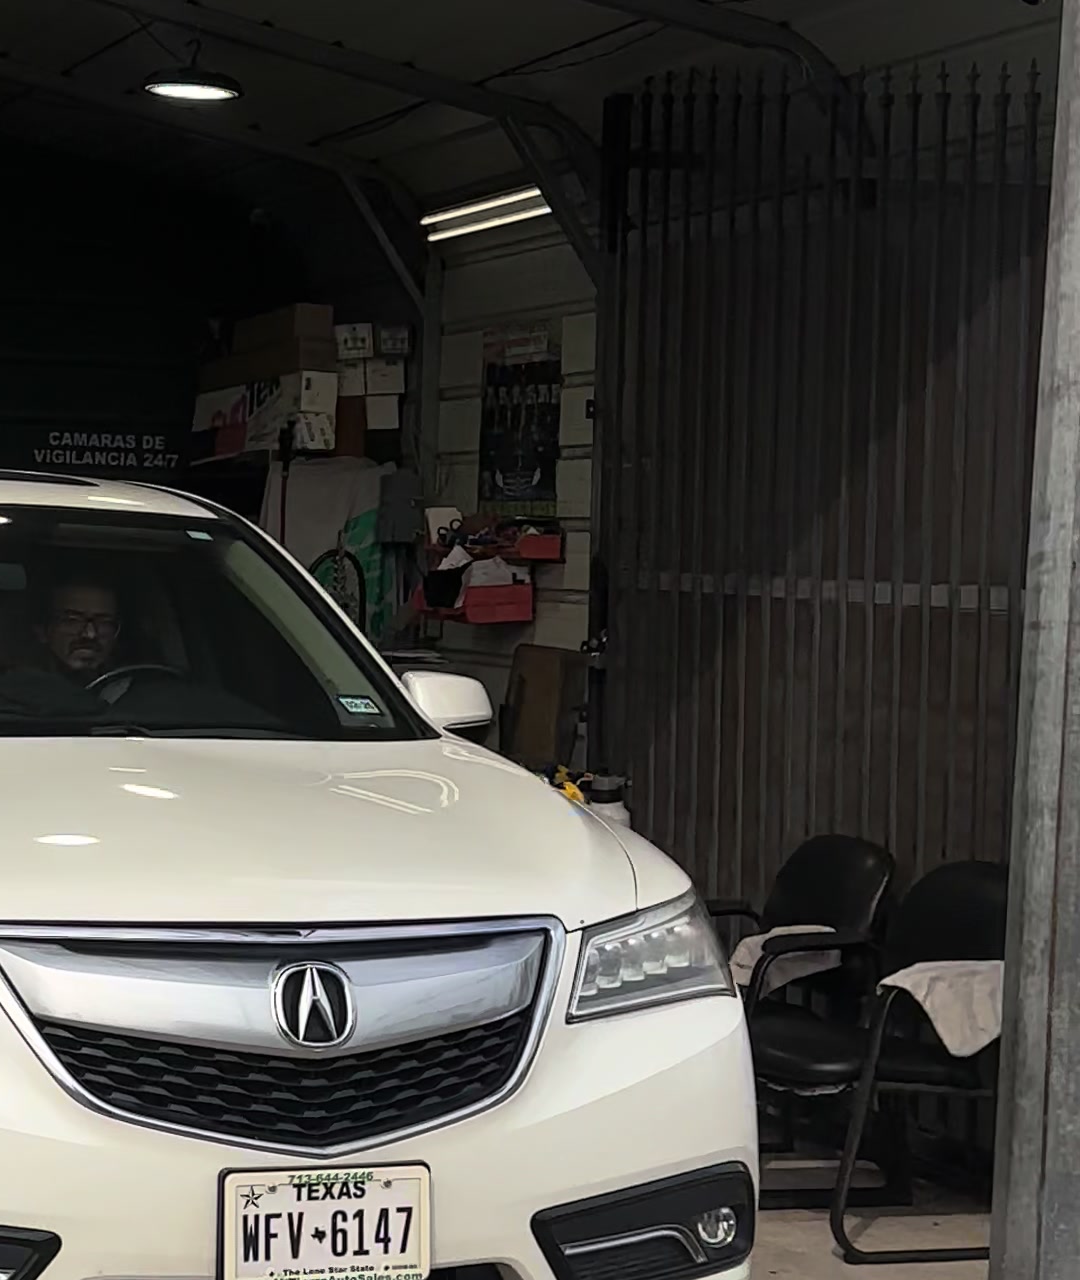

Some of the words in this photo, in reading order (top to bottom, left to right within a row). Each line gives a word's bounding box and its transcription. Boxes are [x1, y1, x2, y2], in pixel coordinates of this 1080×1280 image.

[48, 431, 136, 449] CAMARAS
[142, 435, 166, 450] DE
[143, 454, 179, 468] 24/7
[292, 1180, 367, 1202] TEXAS
[242, 1211, 305, 1263] WFV
[331, 1207, 413, 1257] 6147
[283, 1268, 301, 1277] The
